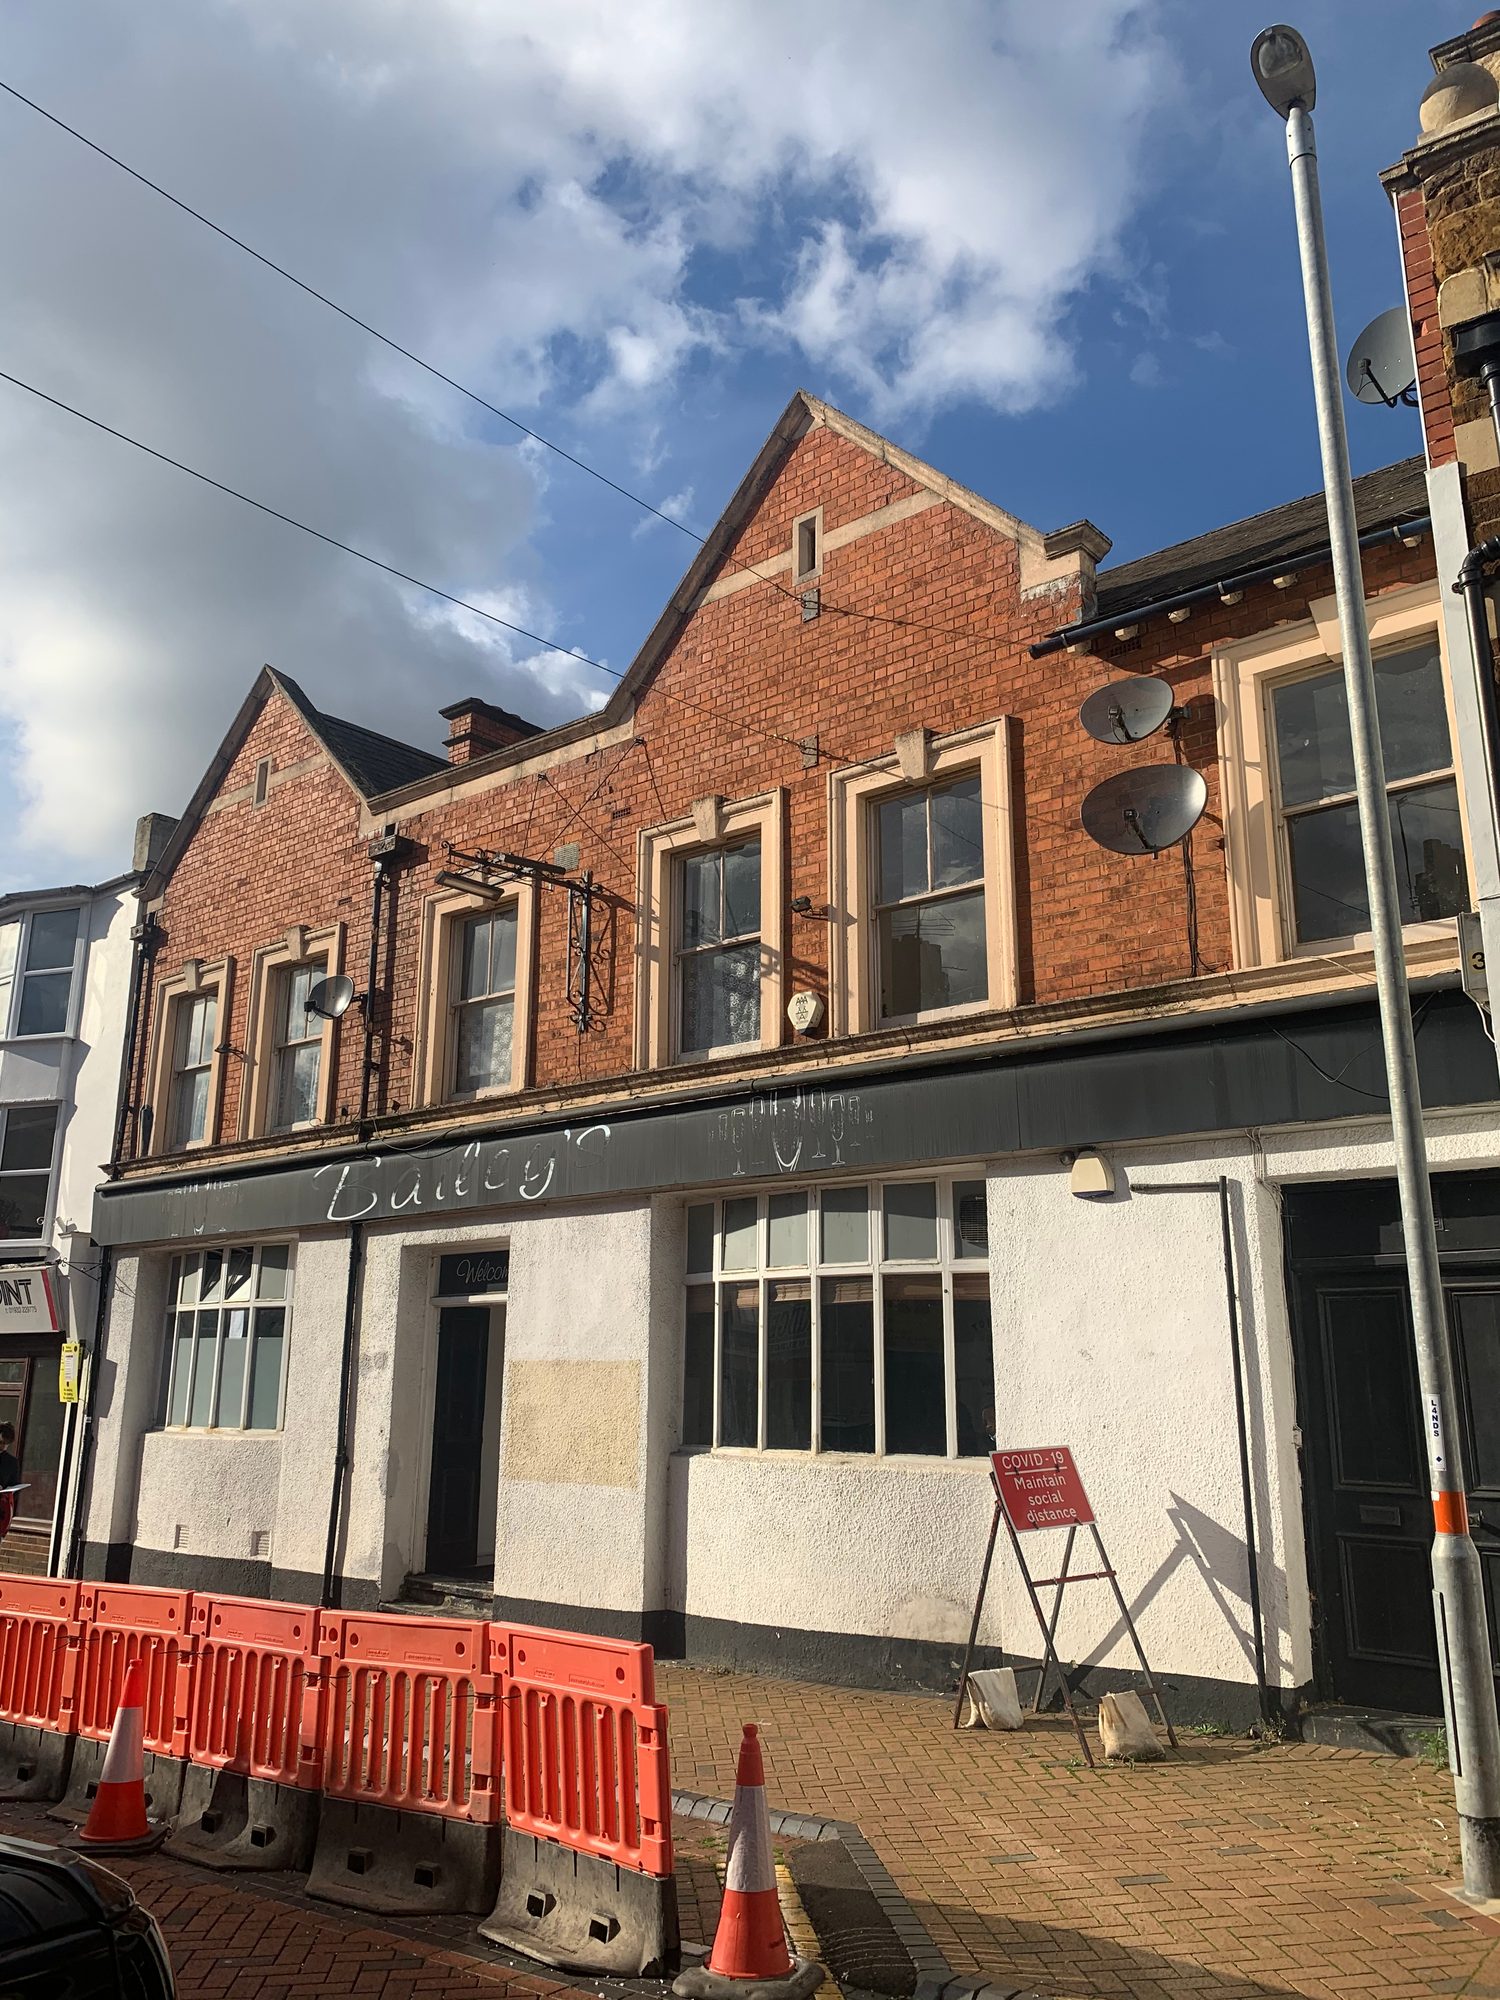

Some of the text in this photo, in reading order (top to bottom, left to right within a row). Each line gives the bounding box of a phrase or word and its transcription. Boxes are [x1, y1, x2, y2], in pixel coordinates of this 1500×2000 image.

[0, 1278, 32, 1306] INT
[1013, 1473, 1067, 1490] Maintain
[1028, 1490, 1065, 1507] social
[1026, 1507, 1077, 1523] distance
